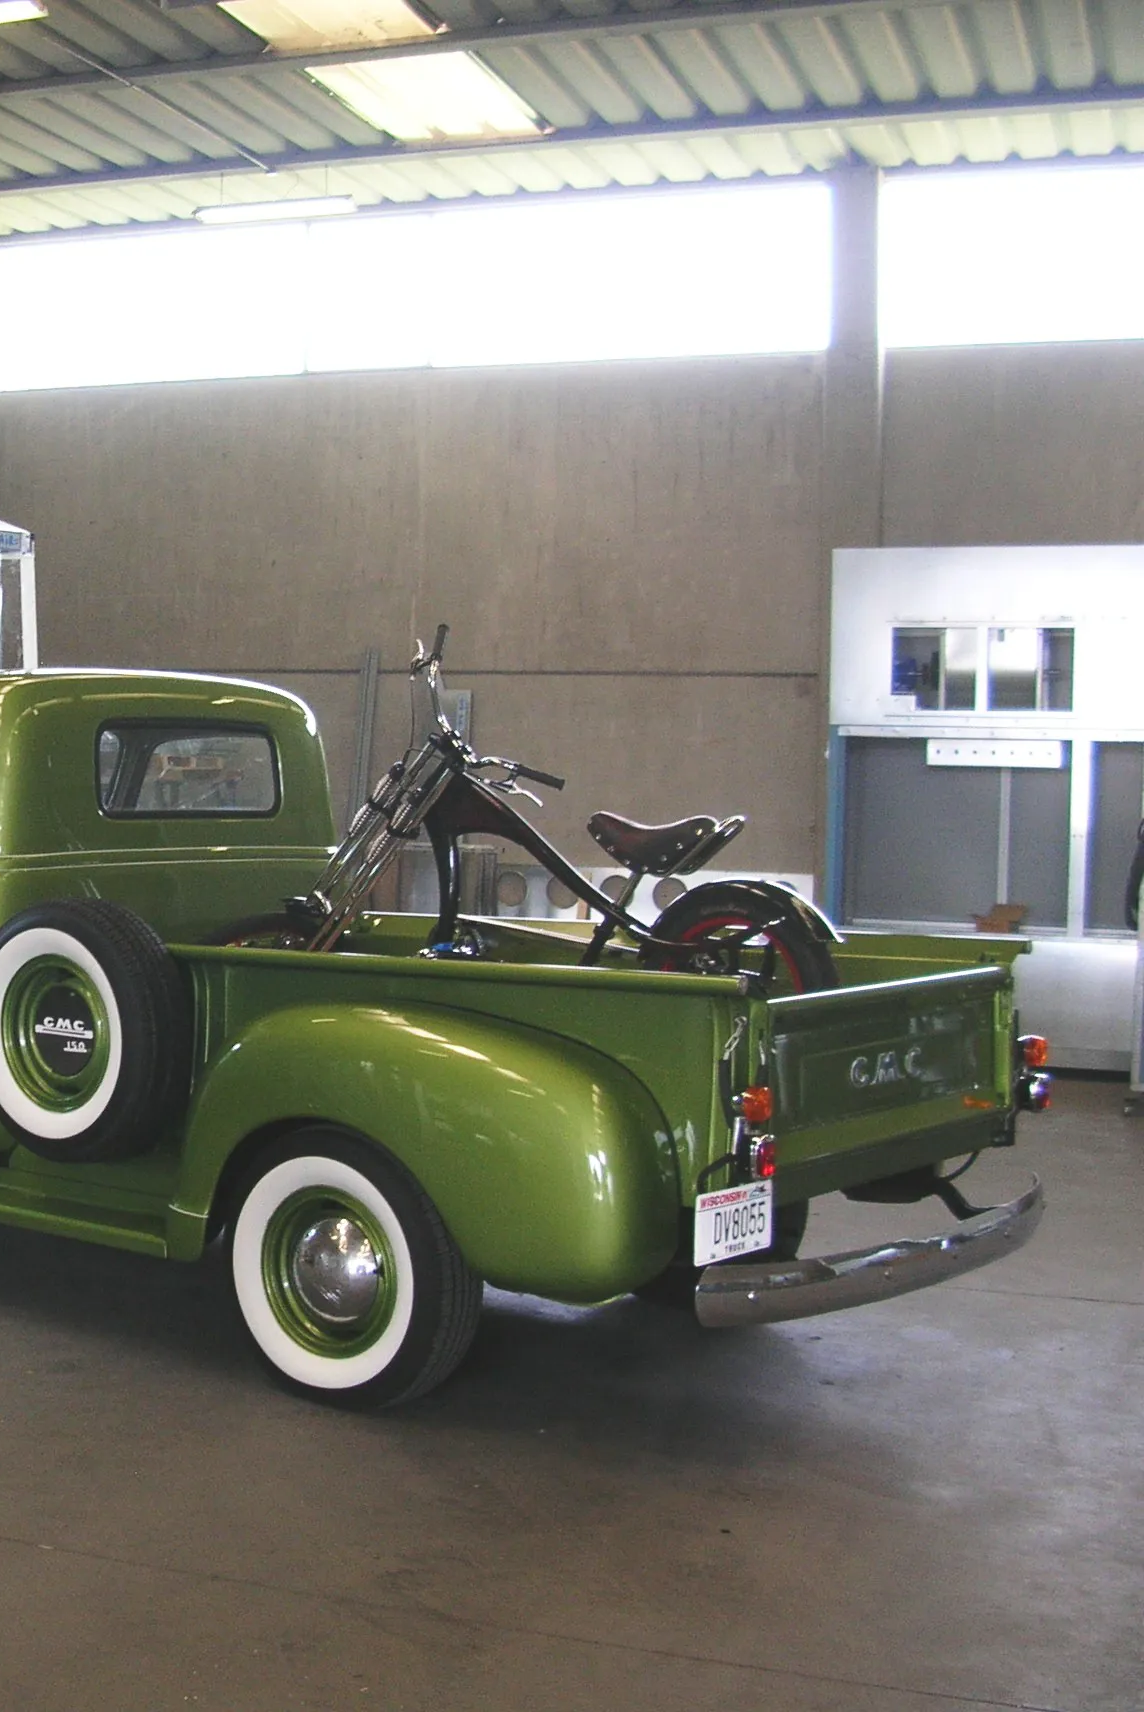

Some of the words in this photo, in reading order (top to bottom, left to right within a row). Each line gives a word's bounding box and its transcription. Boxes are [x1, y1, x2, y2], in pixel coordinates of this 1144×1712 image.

[43, 1016, 85, 1031] GMC
[850, 1046, 922, 1088] GMC
[700, 1191, 742, 1209] WISCONSIN
[714, 1201, 766, 1245] DV8055
